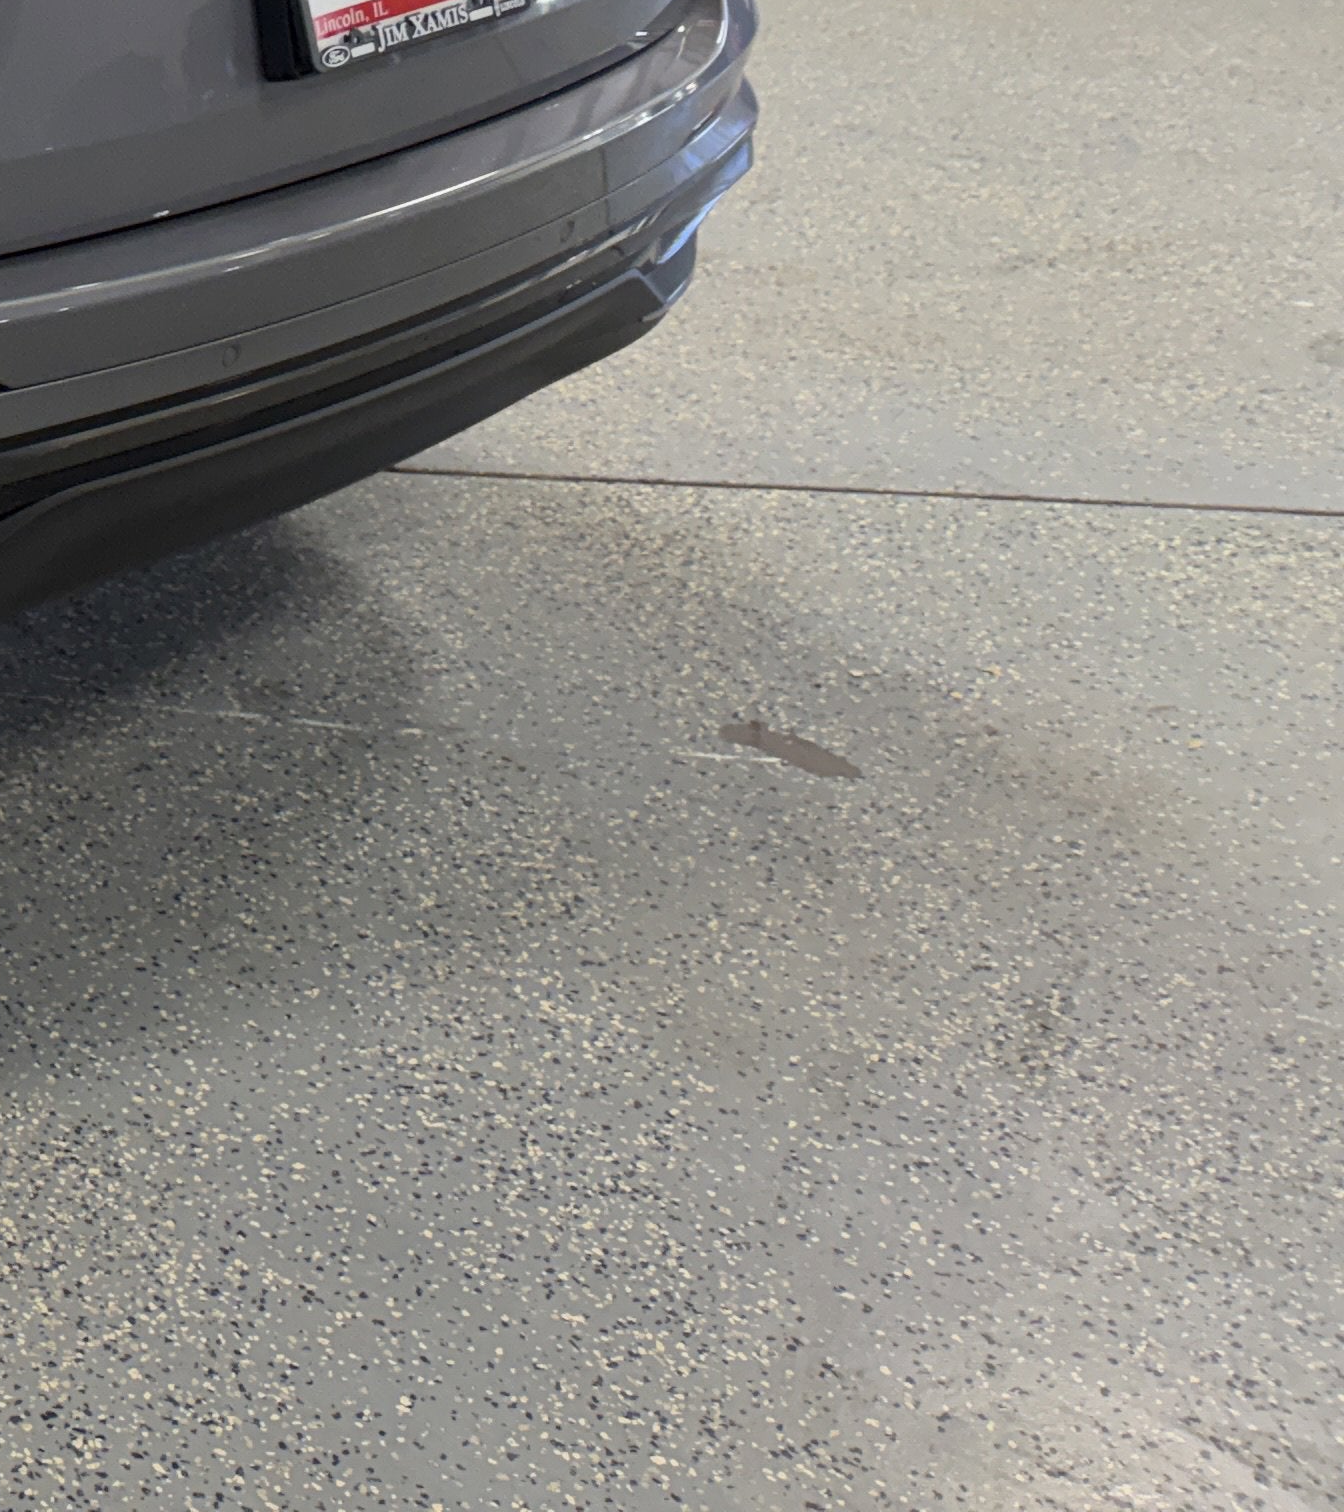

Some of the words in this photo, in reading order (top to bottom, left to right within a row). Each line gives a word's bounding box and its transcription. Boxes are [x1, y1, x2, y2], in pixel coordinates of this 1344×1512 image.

[373, 1, 389, 18] IL
[375, 23, 411, 53] JIM
[409, 4, 470, 38] XAMIS
